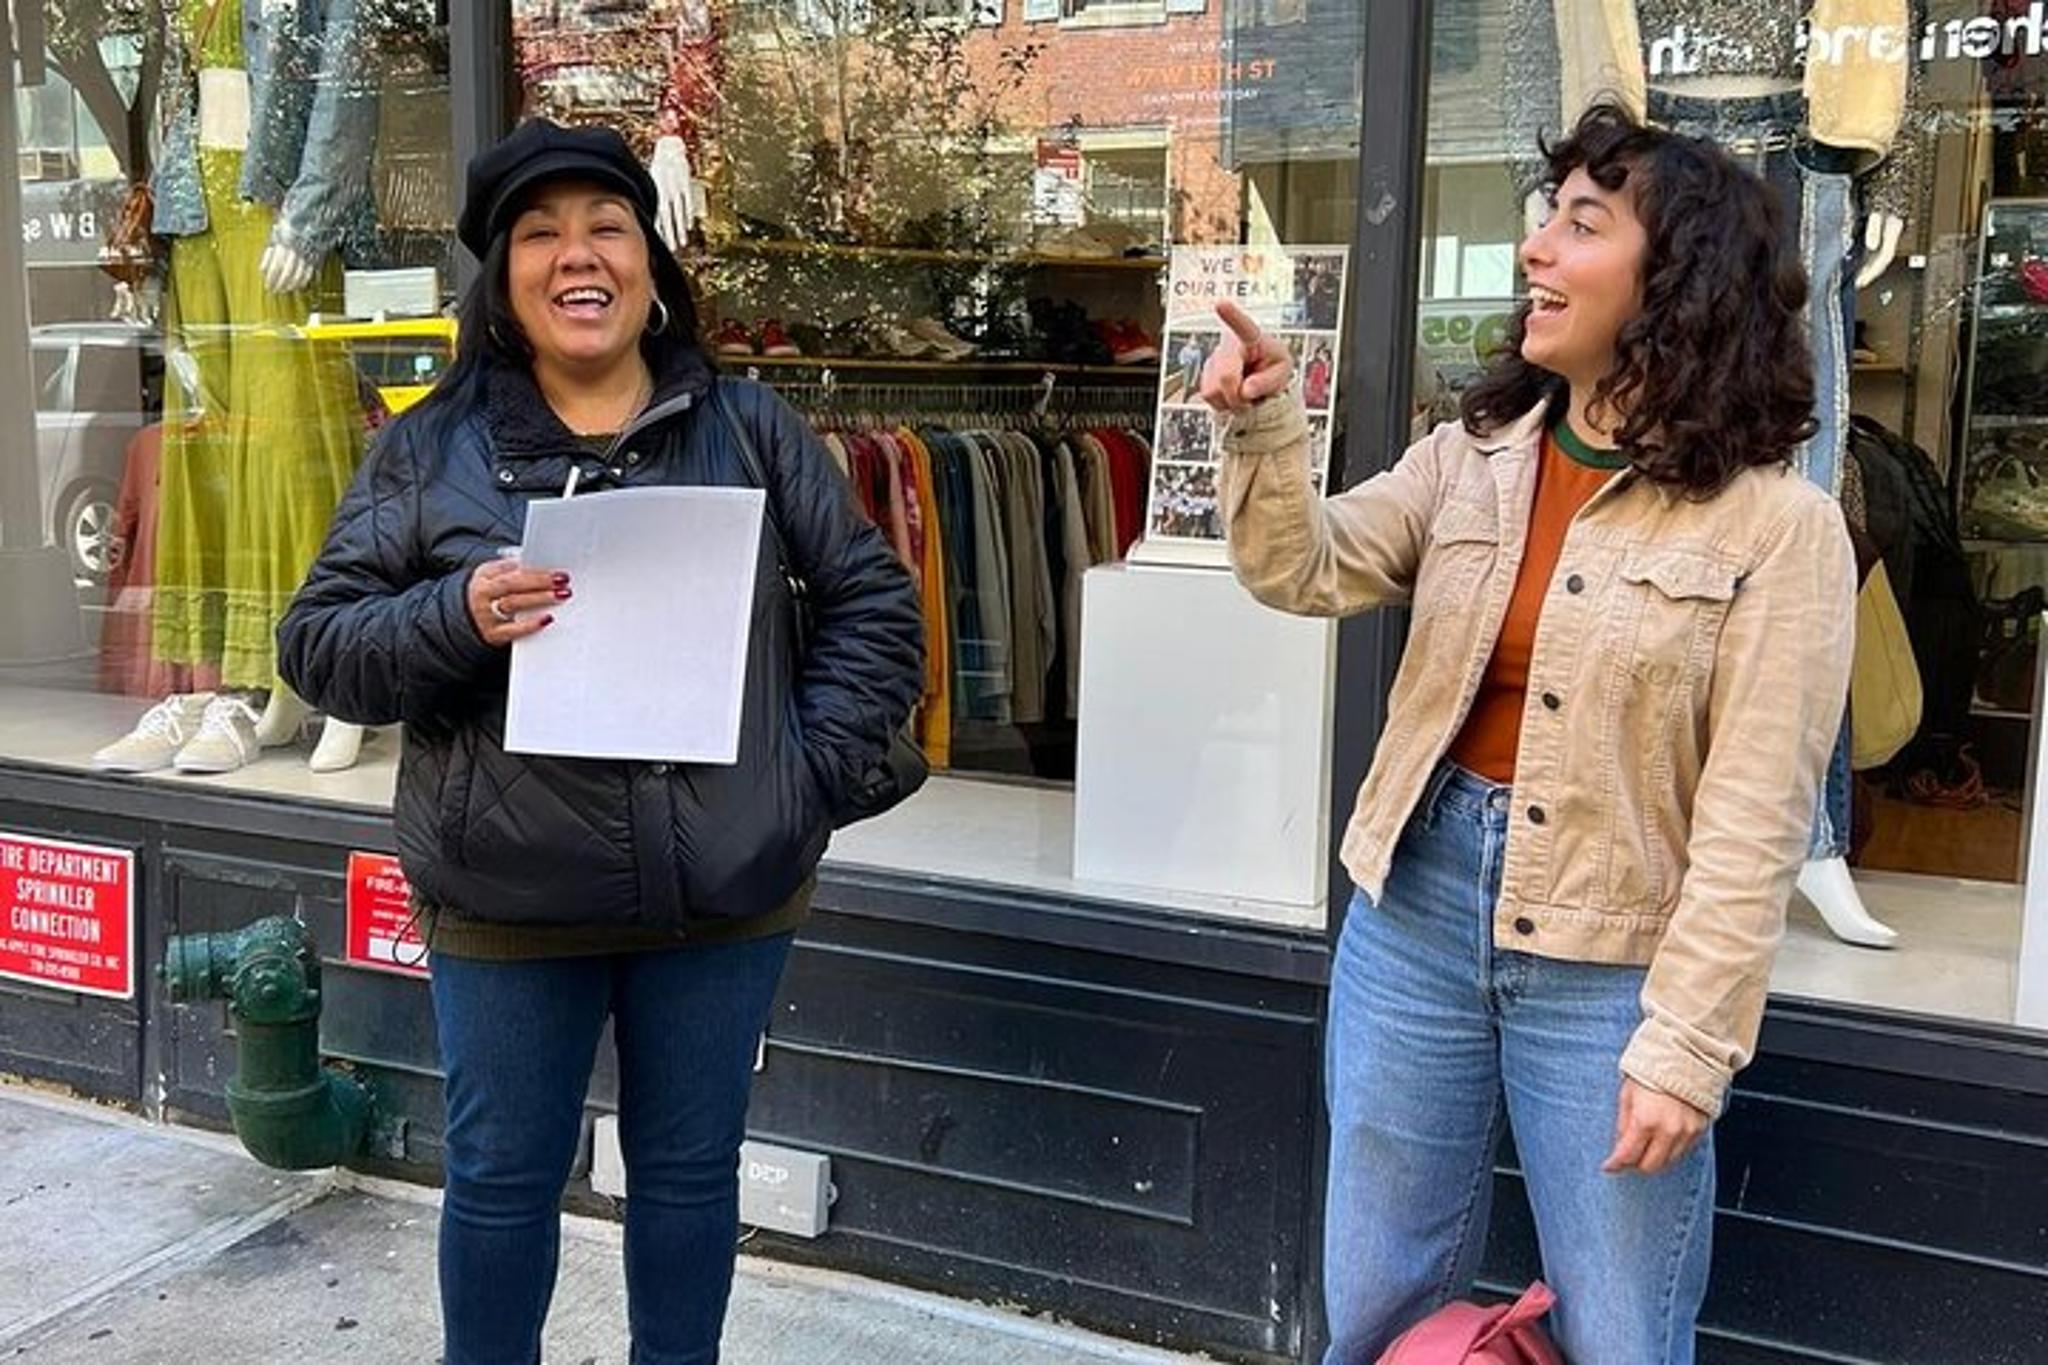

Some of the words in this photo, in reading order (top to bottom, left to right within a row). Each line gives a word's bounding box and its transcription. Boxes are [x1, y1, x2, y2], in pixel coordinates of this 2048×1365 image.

[1249, 58, 1276, 80] ST
[1202, 257, 1234, 274] WE
[1173, 277, 1216, 297] OUR
[28, 848, 119, 885] DEPARTMENT
[16, 876, 96, 912] SPRINKLER
[10, 905, 101, 945] CONNECTION
